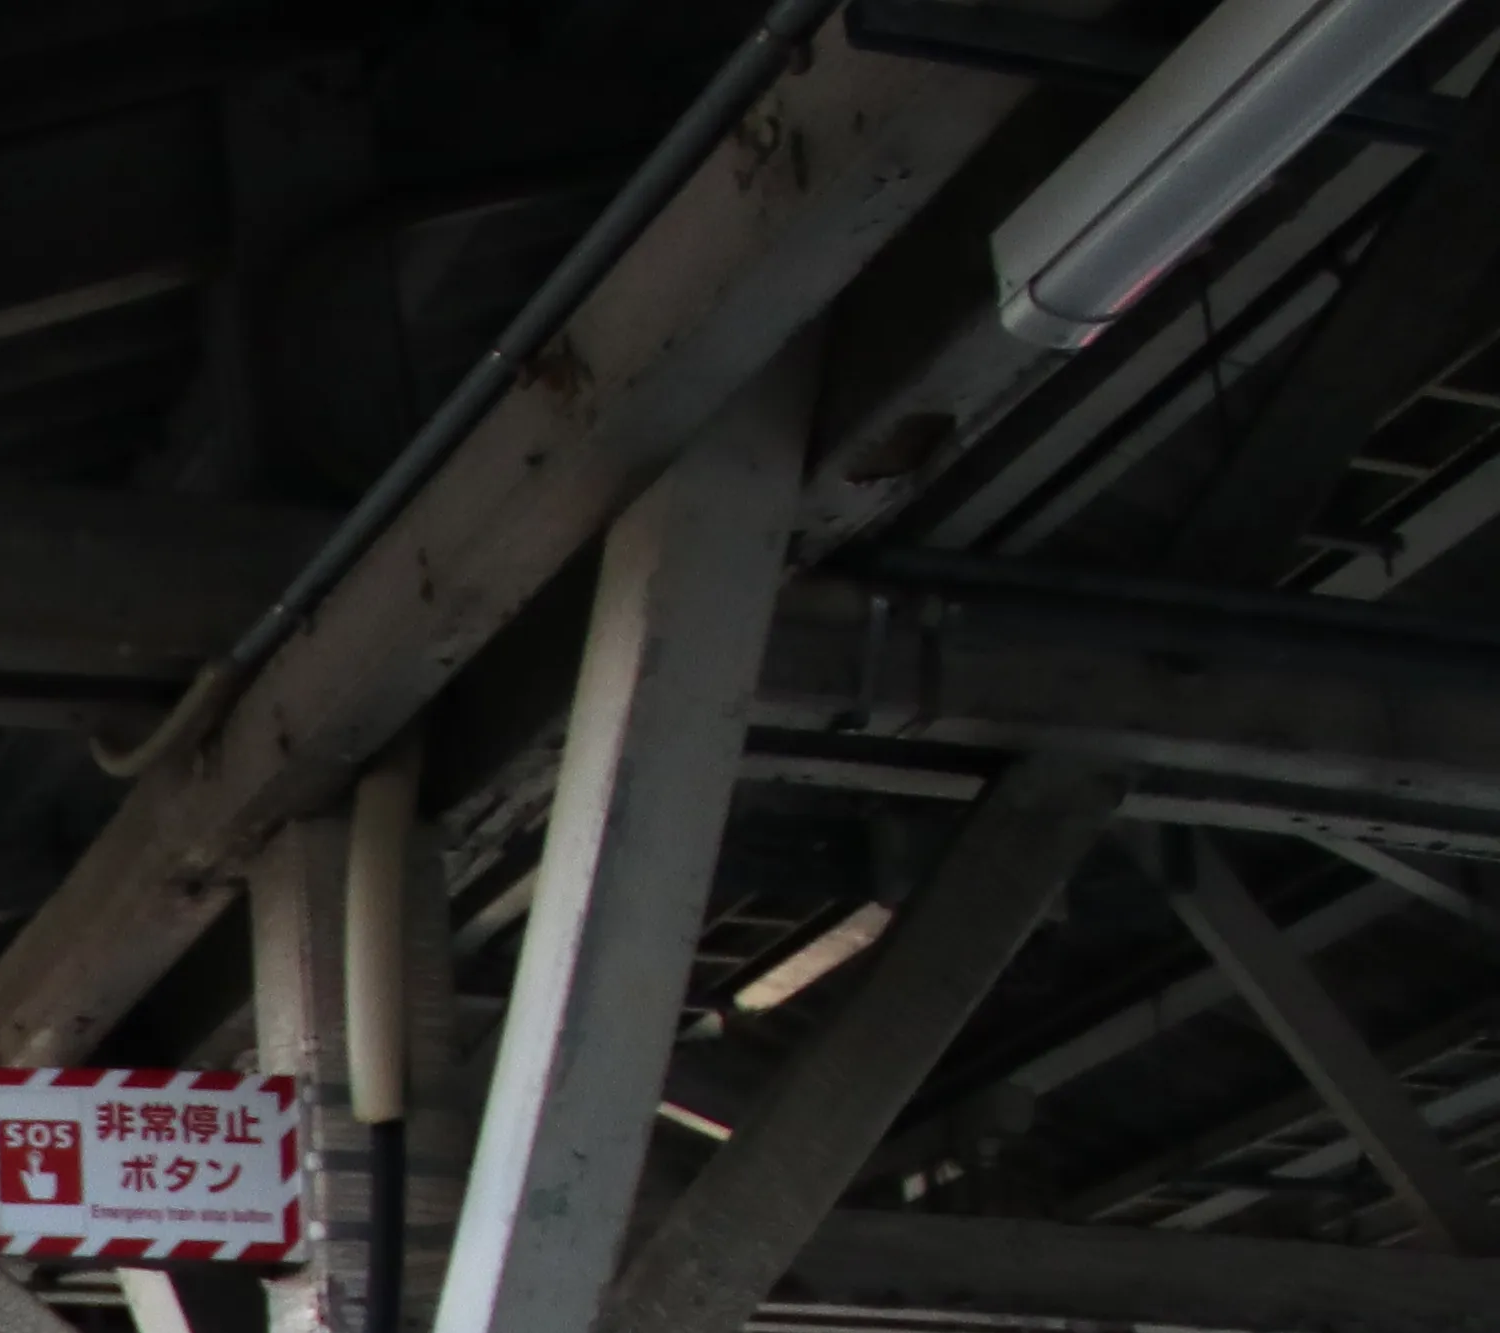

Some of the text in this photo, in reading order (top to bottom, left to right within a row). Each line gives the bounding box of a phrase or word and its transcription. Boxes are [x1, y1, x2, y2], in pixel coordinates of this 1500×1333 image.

[4, 1122, 74, 1149] SOS
[97, 1102, 264, 1145] 非常停止
[121, 1153, 242, 1194] ボタン
